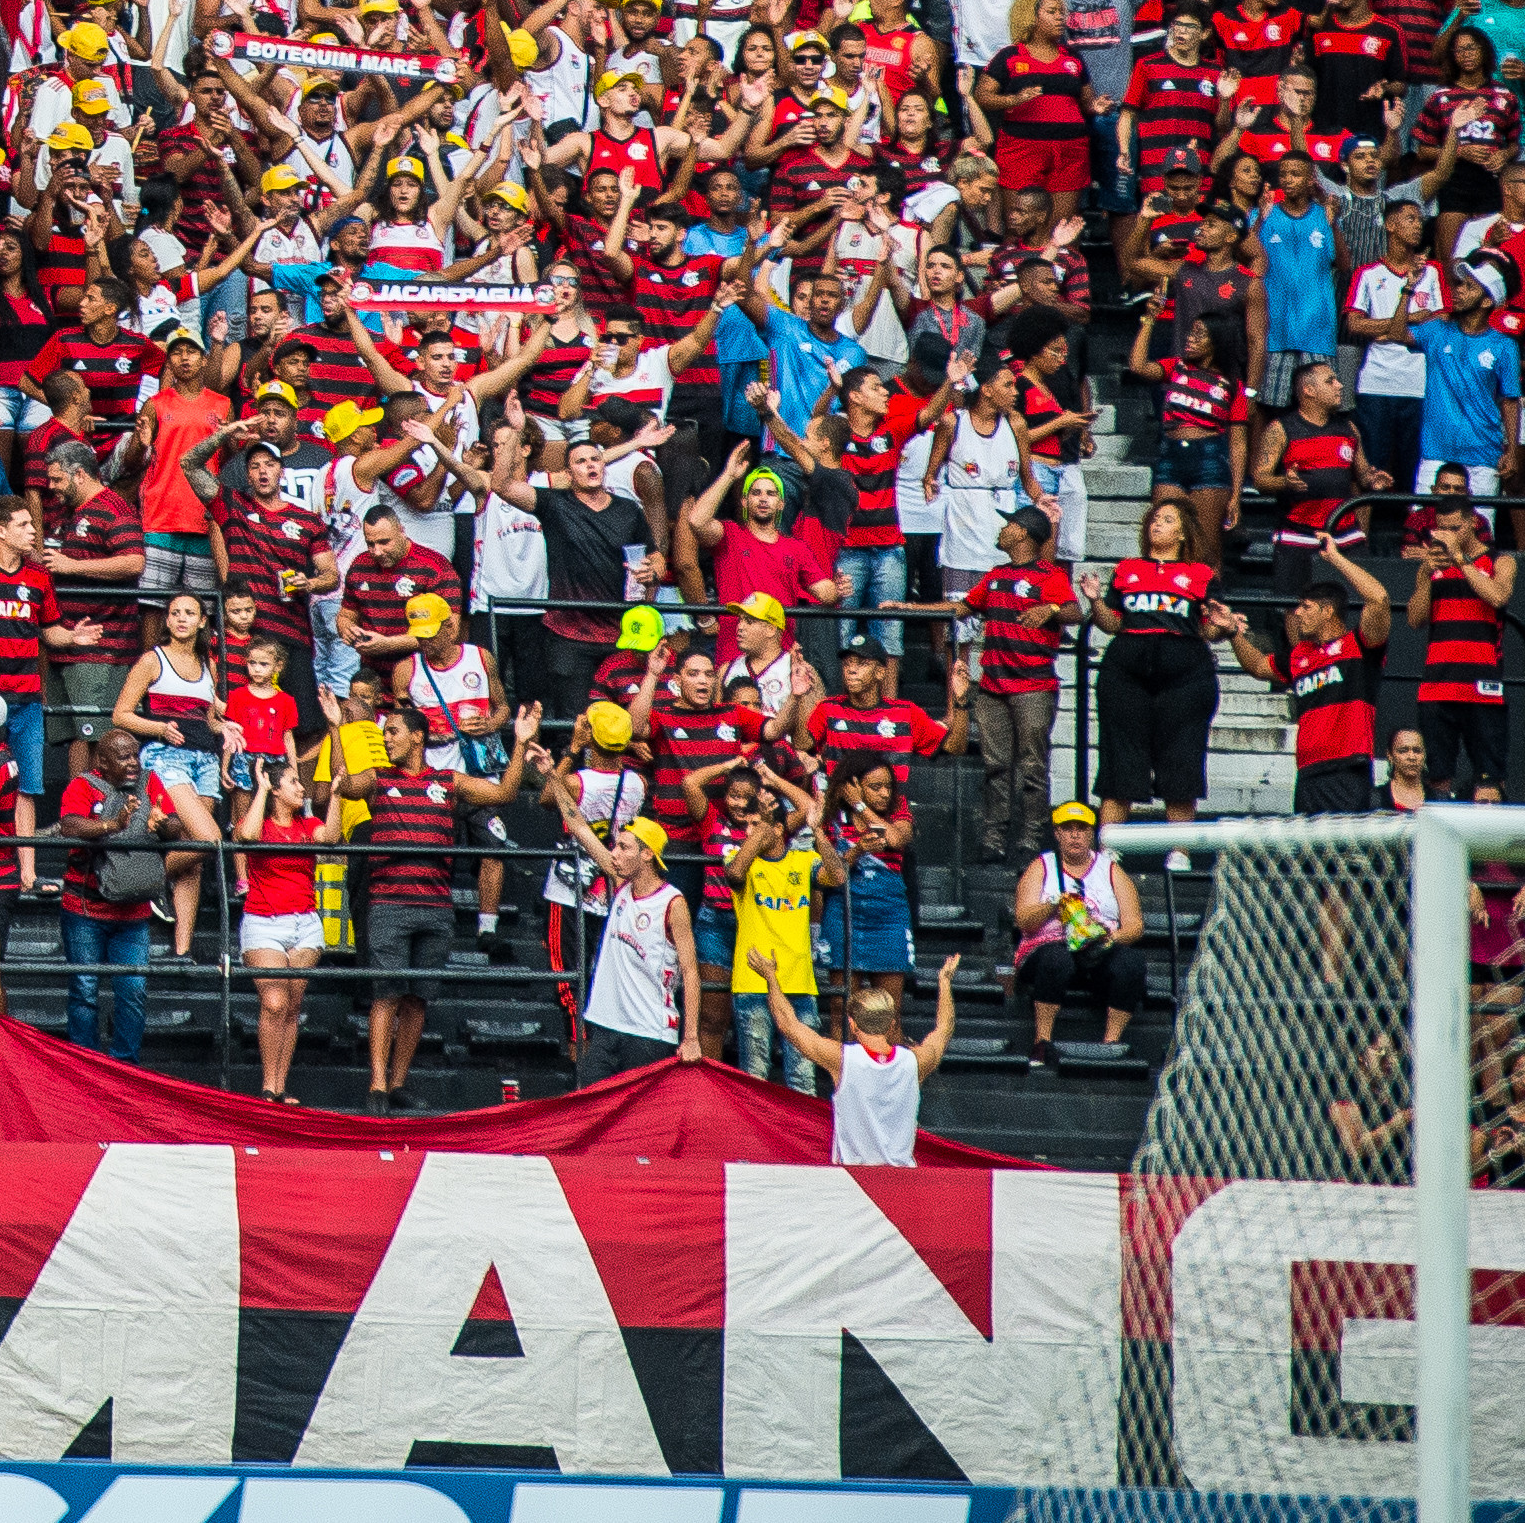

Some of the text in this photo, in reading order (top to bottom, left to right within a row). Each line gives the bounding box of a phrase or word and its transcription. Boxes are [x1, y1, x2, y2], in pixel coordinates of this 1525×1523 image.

[245, 39, 424, 78] BOTEQUIM MARÉ
[1167, 390, 1213, 415] CAIXA
[1122, 594, 1190, 618] CAIXA
[1295, 666, 1344, 697] CAIXA
